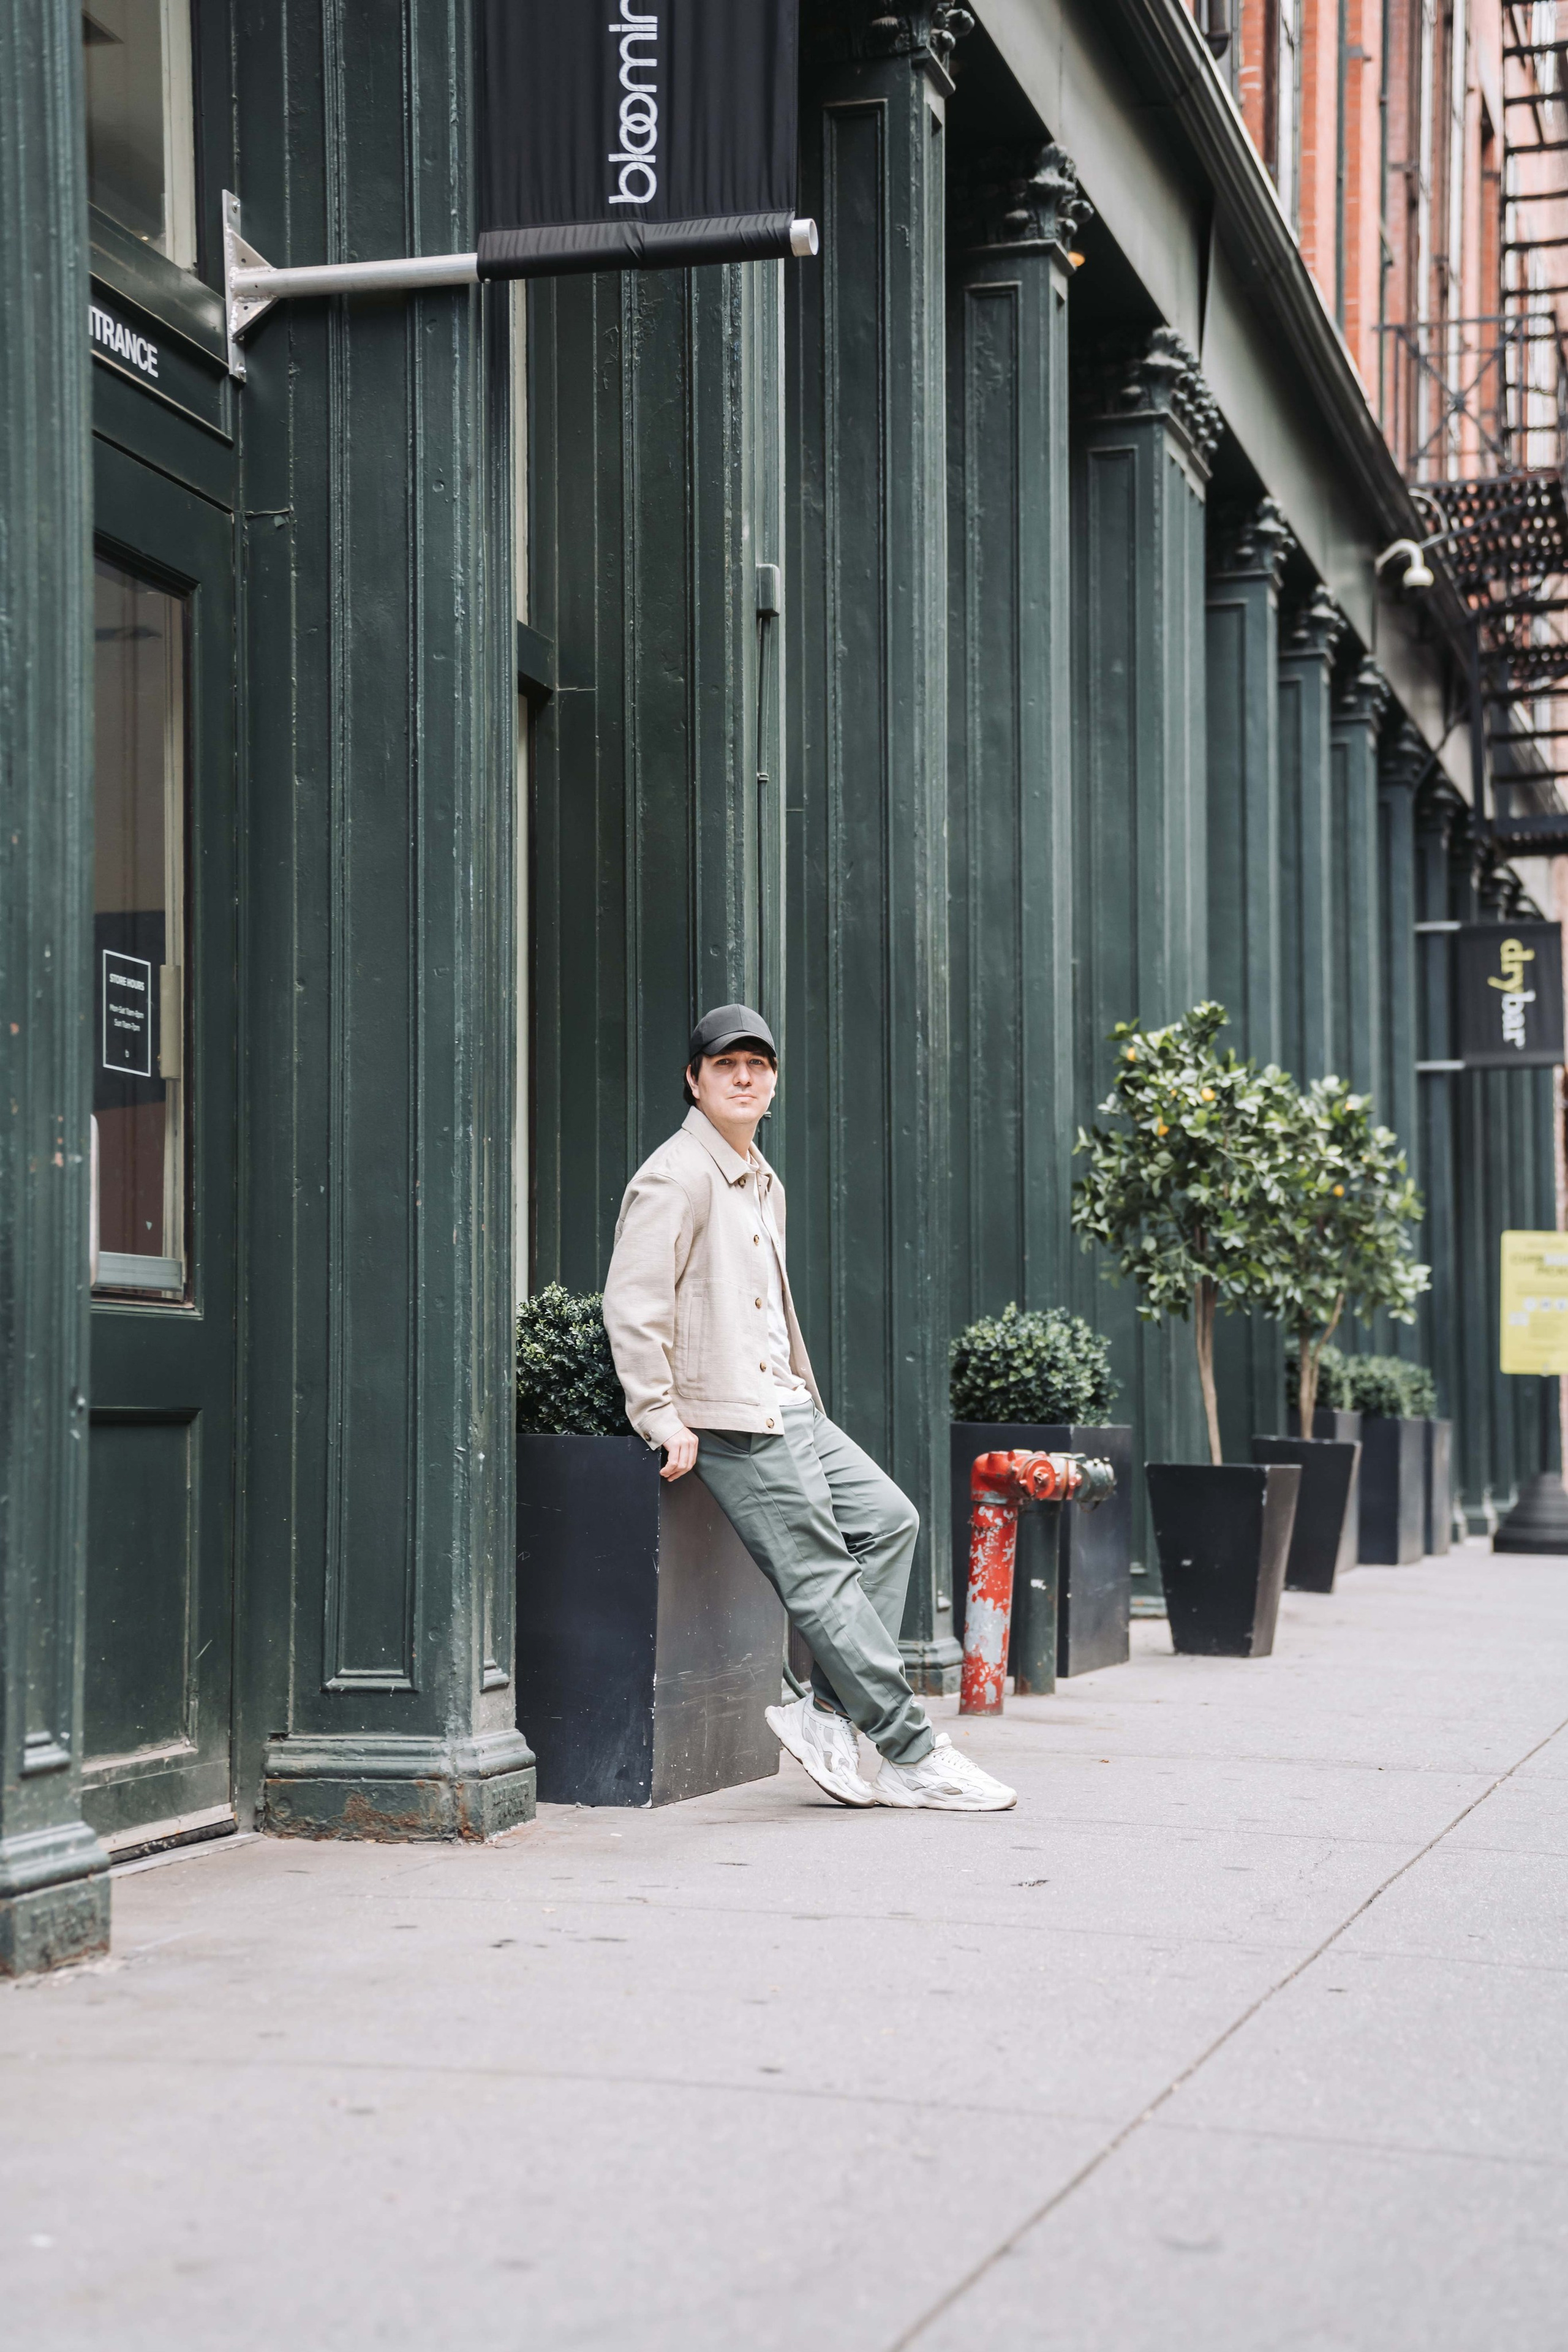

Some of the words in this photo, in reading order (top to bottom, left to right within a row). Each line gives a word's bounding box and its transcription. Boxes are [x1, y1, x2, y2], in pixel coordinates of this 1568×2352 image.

[109, 973, 127, 987] STORE
[127, 978, 145, 991] HOURS
[1487, 938, 1536, 1049] drybar
